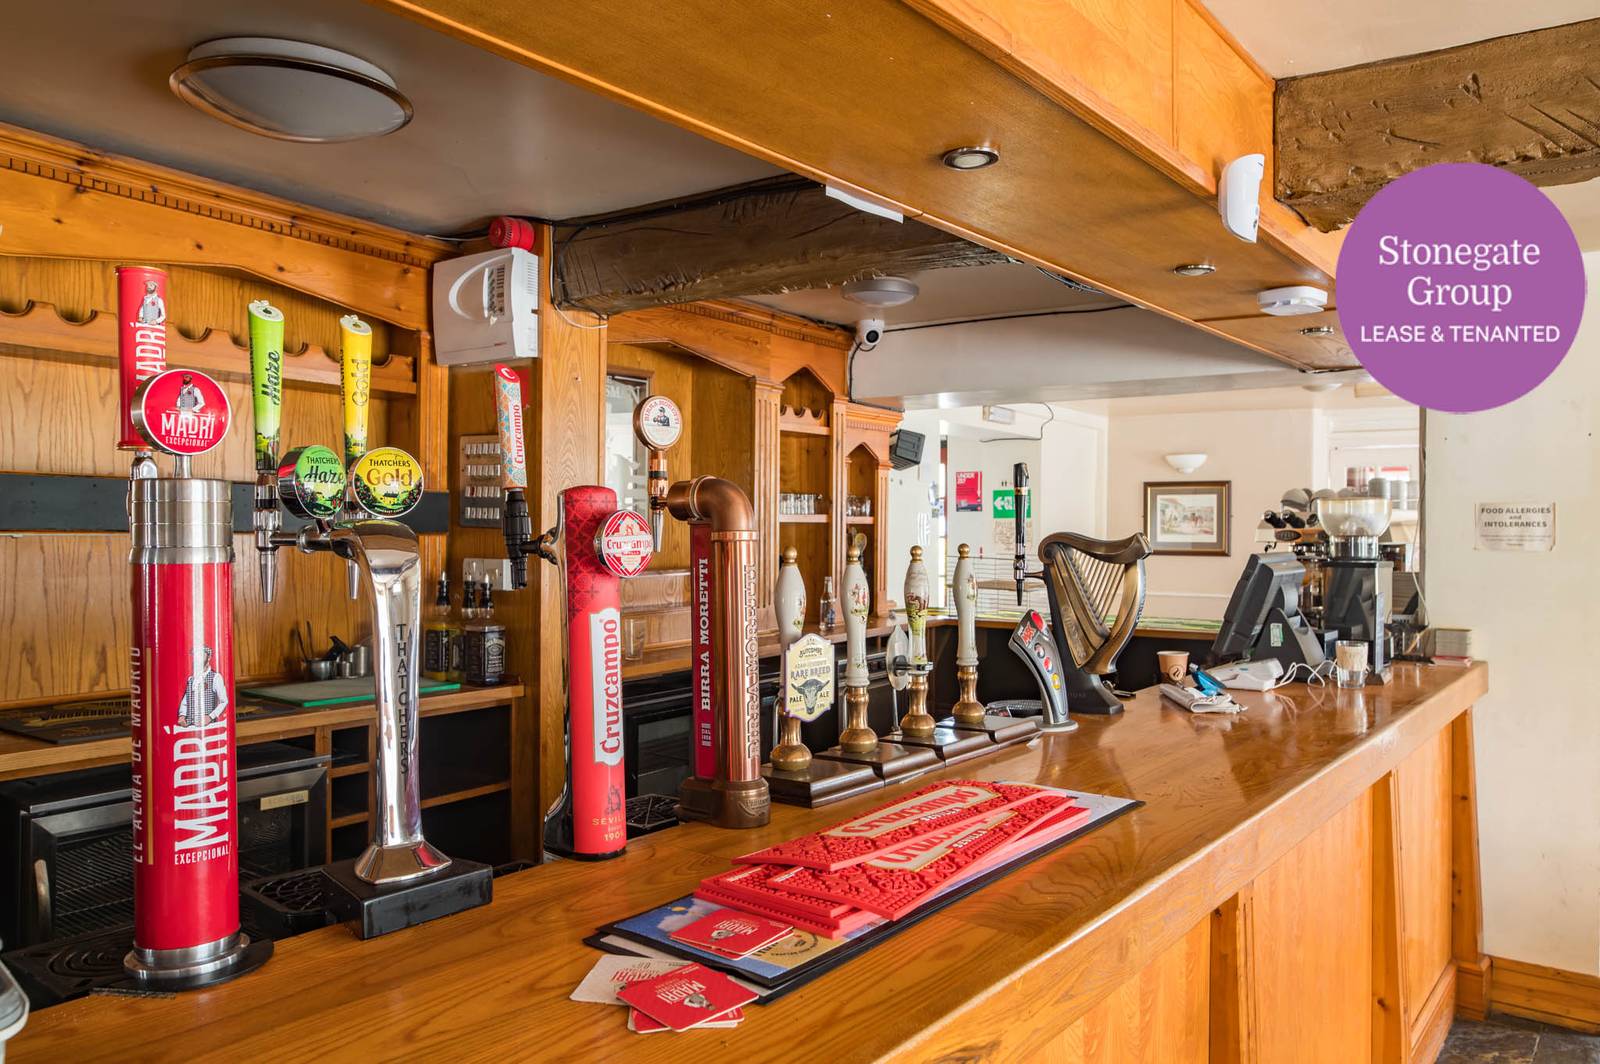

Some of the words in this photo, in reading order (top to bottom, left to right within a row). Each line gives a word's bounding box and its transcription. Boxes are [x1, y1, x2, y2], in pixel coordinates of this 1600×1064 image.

[261, 350, 281, 406] Haze
[351, 358, 369, 407] Gold
[513, 403, 524, 465] Cruzcampo
[304, 465, 346, 485] Haze
[366, 468, 413, 487] Gold
[369, 459, 411, 467] THATCHERS
[699, 558, 710, 646] MORETTI
[130, 647, 142, 728] MADRID
[396, 623, 409, 775] THATCHERS
[600, 618, 621, 754] Cruzcampo
[700, 651, 711, 711] BIRRA
[789, 695, 803, 704] PALE
[791, 669, 809, 680] RARE
[810, 665, 831, 677] BREED
[132, 774, 143, 830] ALMA
[163, 717, 229, 852] MADRÍ
[174, 843, 230, 865] EXCEPCIONAL
